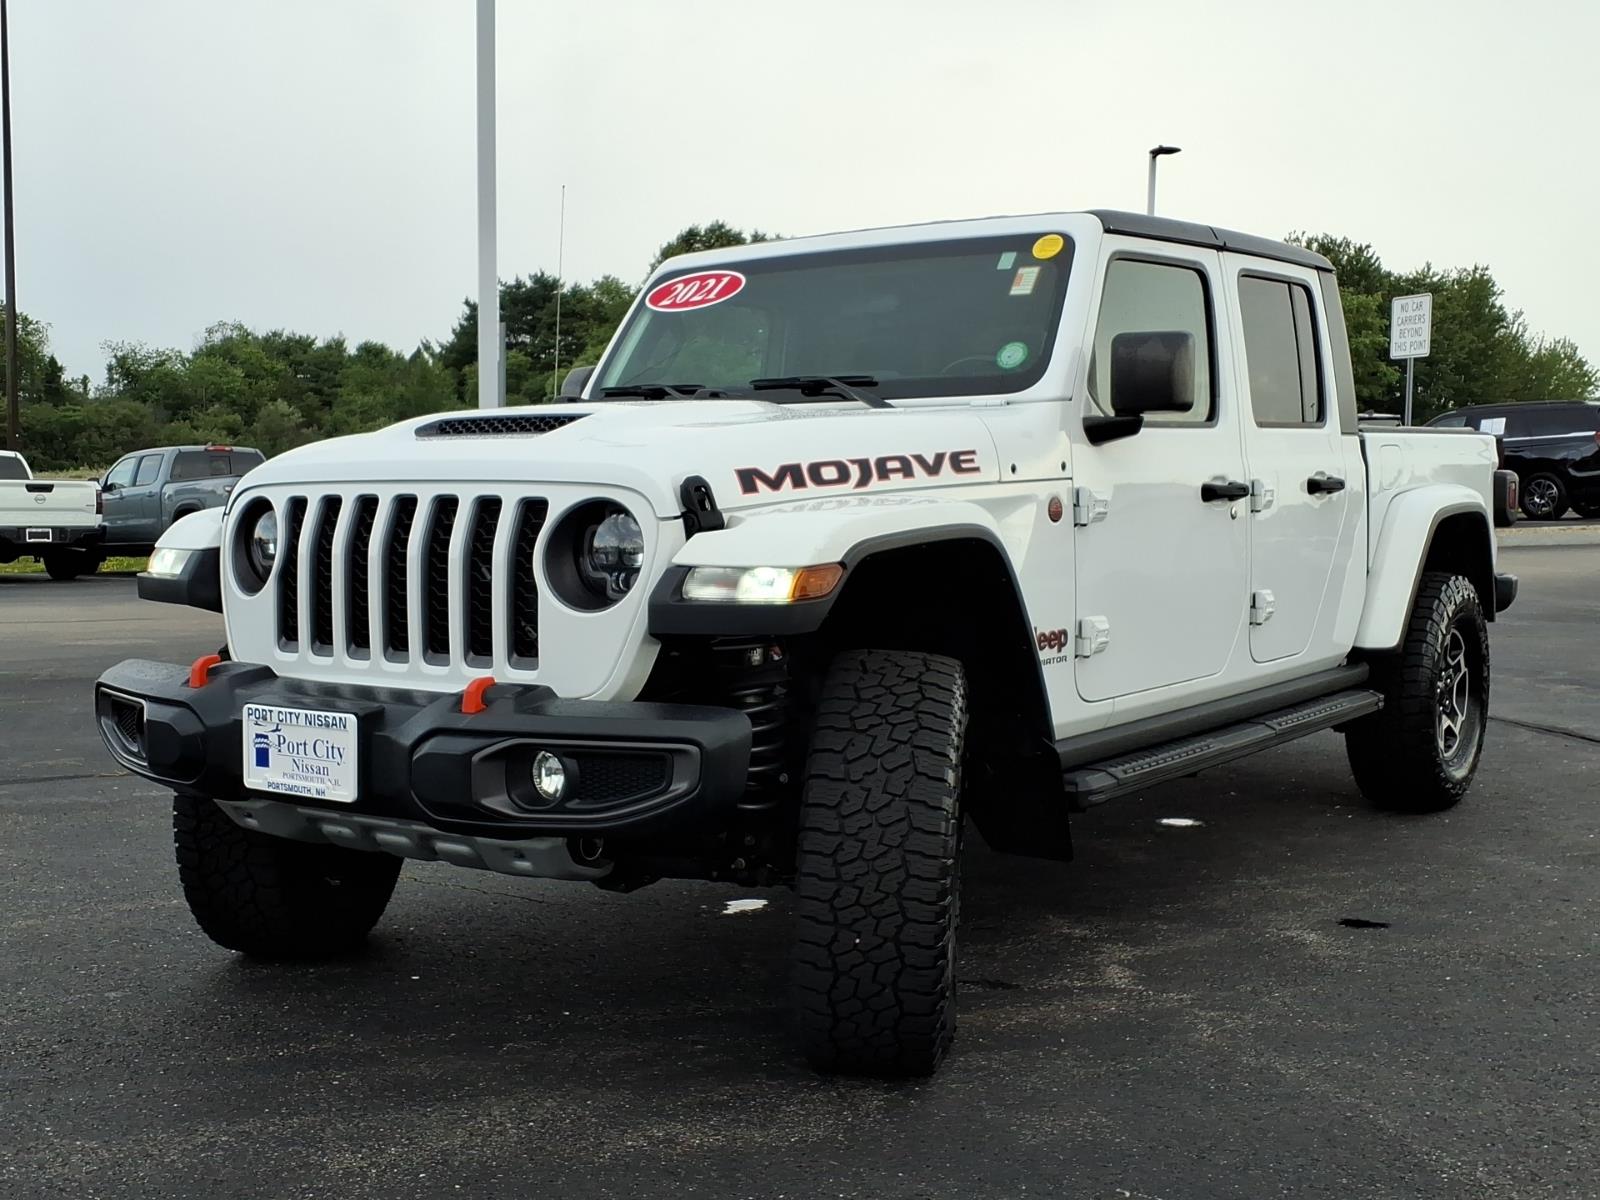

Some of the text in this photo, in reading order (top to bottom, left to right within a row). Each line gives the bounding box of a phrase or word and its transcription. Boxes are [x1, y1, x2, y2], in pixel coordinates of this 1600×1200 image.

[657, 275, 732, 306] 2021
[1400, 301, 1424, 313] NO CAR
[1397, 313, 1426, 326] CARRIERS
[1399, 327, 1423, 339] BEYOND
[1394, 339, 1426, 352] THIS POINT
[734, 449, 981, 495] MOJAVE
[1041, 655, 1068, 666] IATOR
[247, 707, 347, 729] PORT CITY NISSAN
[277, 734, 345, 766] Port City
[292, 758, 329, 776] Nissan
[316, 787, 326, 796] NH
